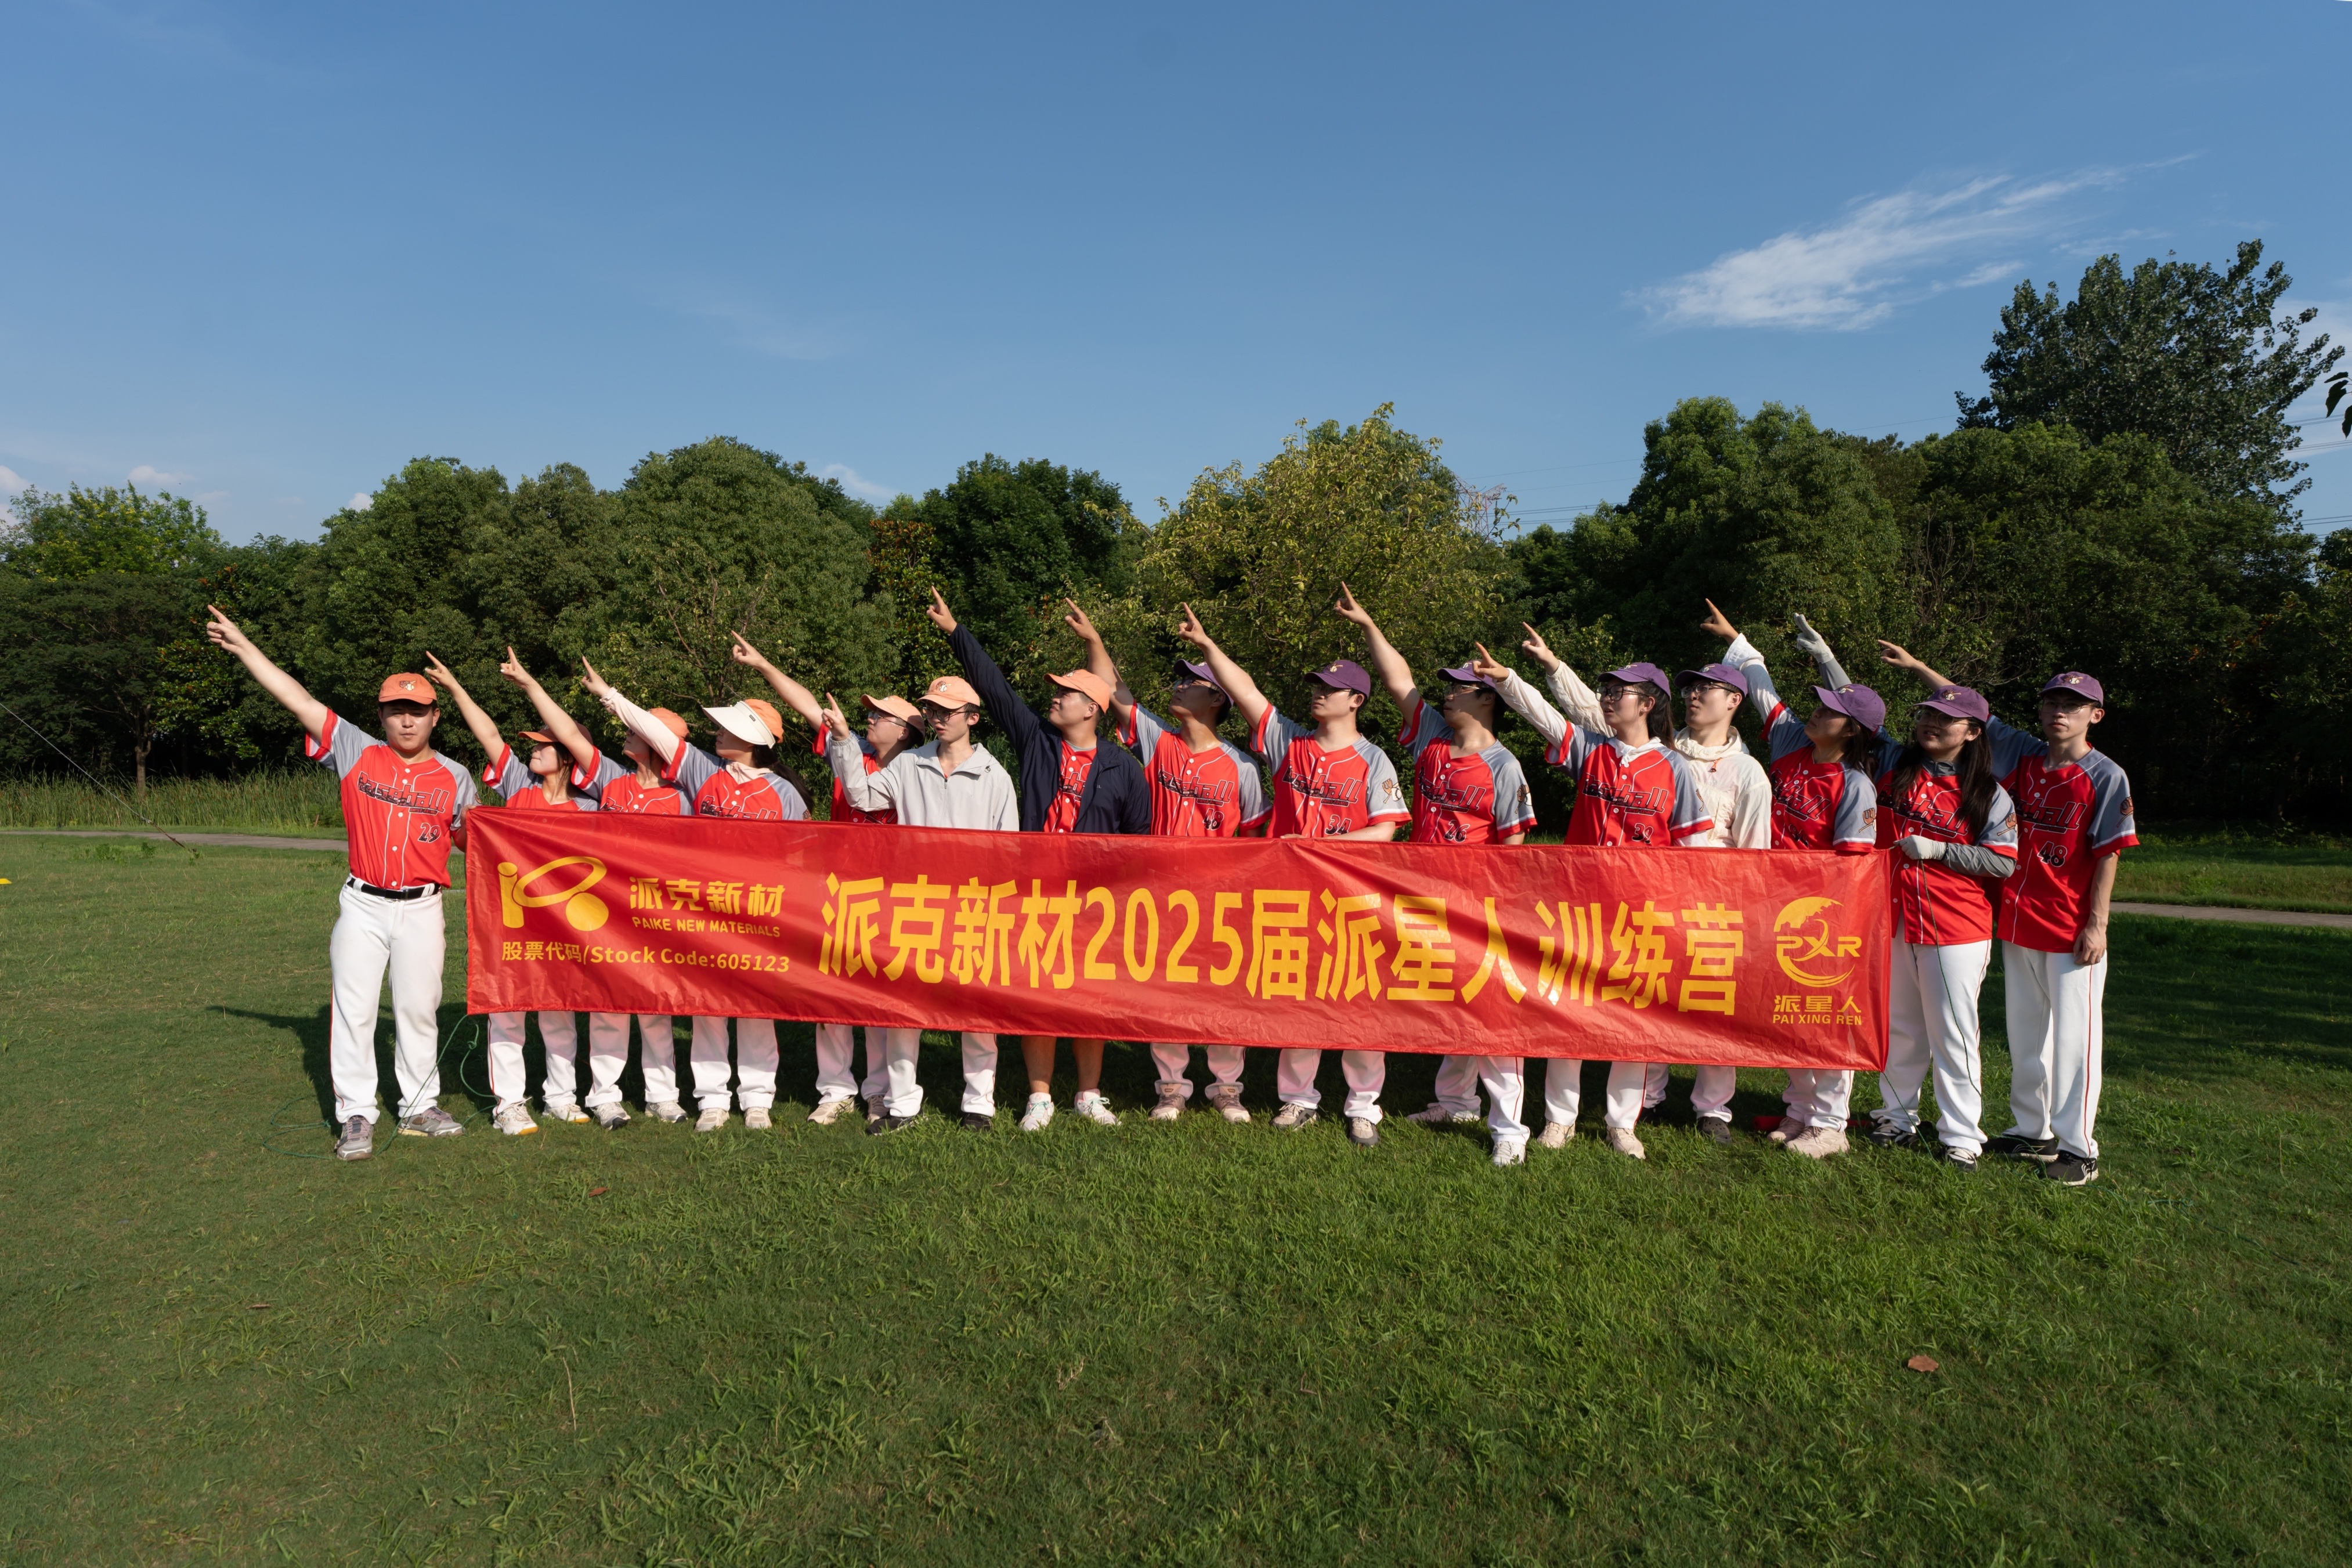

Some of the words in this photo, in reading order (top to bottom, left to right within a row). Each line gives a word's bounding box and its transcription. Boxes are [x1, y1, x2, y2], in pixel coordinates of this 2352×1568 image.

[1202, 807, 1224, 830] 48
[1324, 814, 1352, 835] 34
[417, 822, 442, 843] 29
[1443, 820, 1470, 842] 26
[2037, 841, 2068, 867] 48
[629, 876, 785, 917] 派克新材
[633, 916, 672, 931] PAIKE
[677, 919, 705, 932] NEW
[710, 920, 781, 937] MATERIALS
[817, 872, 1744, 1016] 派克新材2025届派星人训练营
[660, 948, 789, 973] Code:605123
[1773, 995, 1862, 1014] 派星人
[1773, 1014, 1794, 1024] PAI
[1798, 1015, 1831, 1025] XING
[1836, 1016, 1862, 1025] REN
